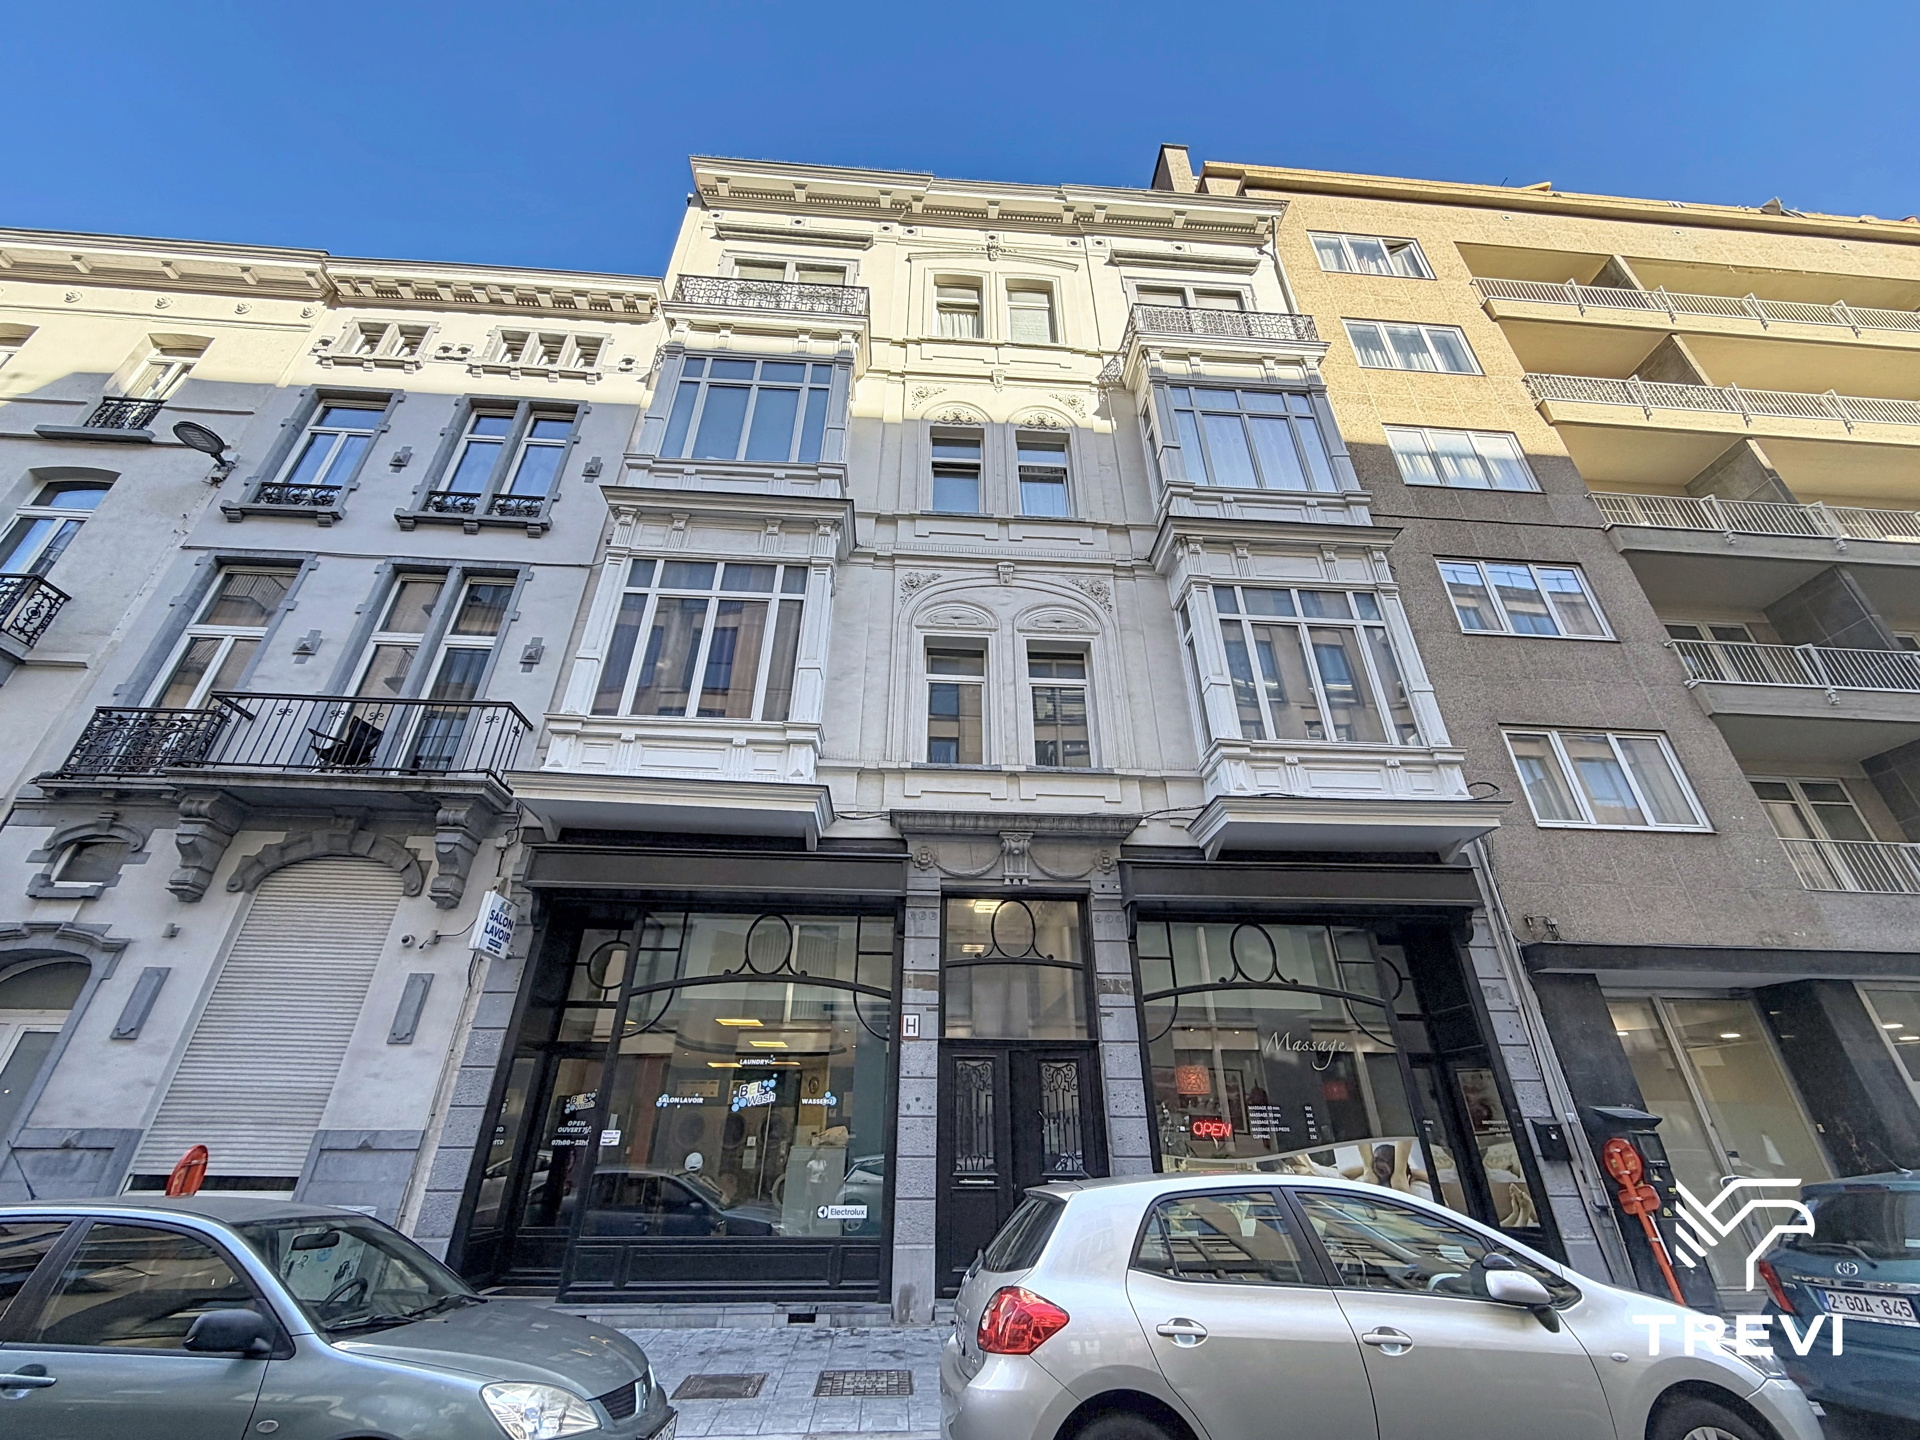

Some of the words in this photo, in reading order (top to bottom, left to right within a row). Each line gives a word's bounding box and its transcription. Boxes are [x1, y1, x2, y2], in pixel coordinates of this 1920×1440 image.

[489, 909, 514, 931] SALON
[484, 922, 511, 944] LAVOIR
[905, 1017, 917, 1034] H
[1265, 1031, 1348, 1071] Massage
[739, 1058, 769, 1066] LAUNDRY
[740, 1081, 765, 1097] BEL
[747, 1091, 776, 1107] Wash
[1193, 1121, 1232, 1137] OPEN
[830, 1208, 865, 1216] Electrolux
